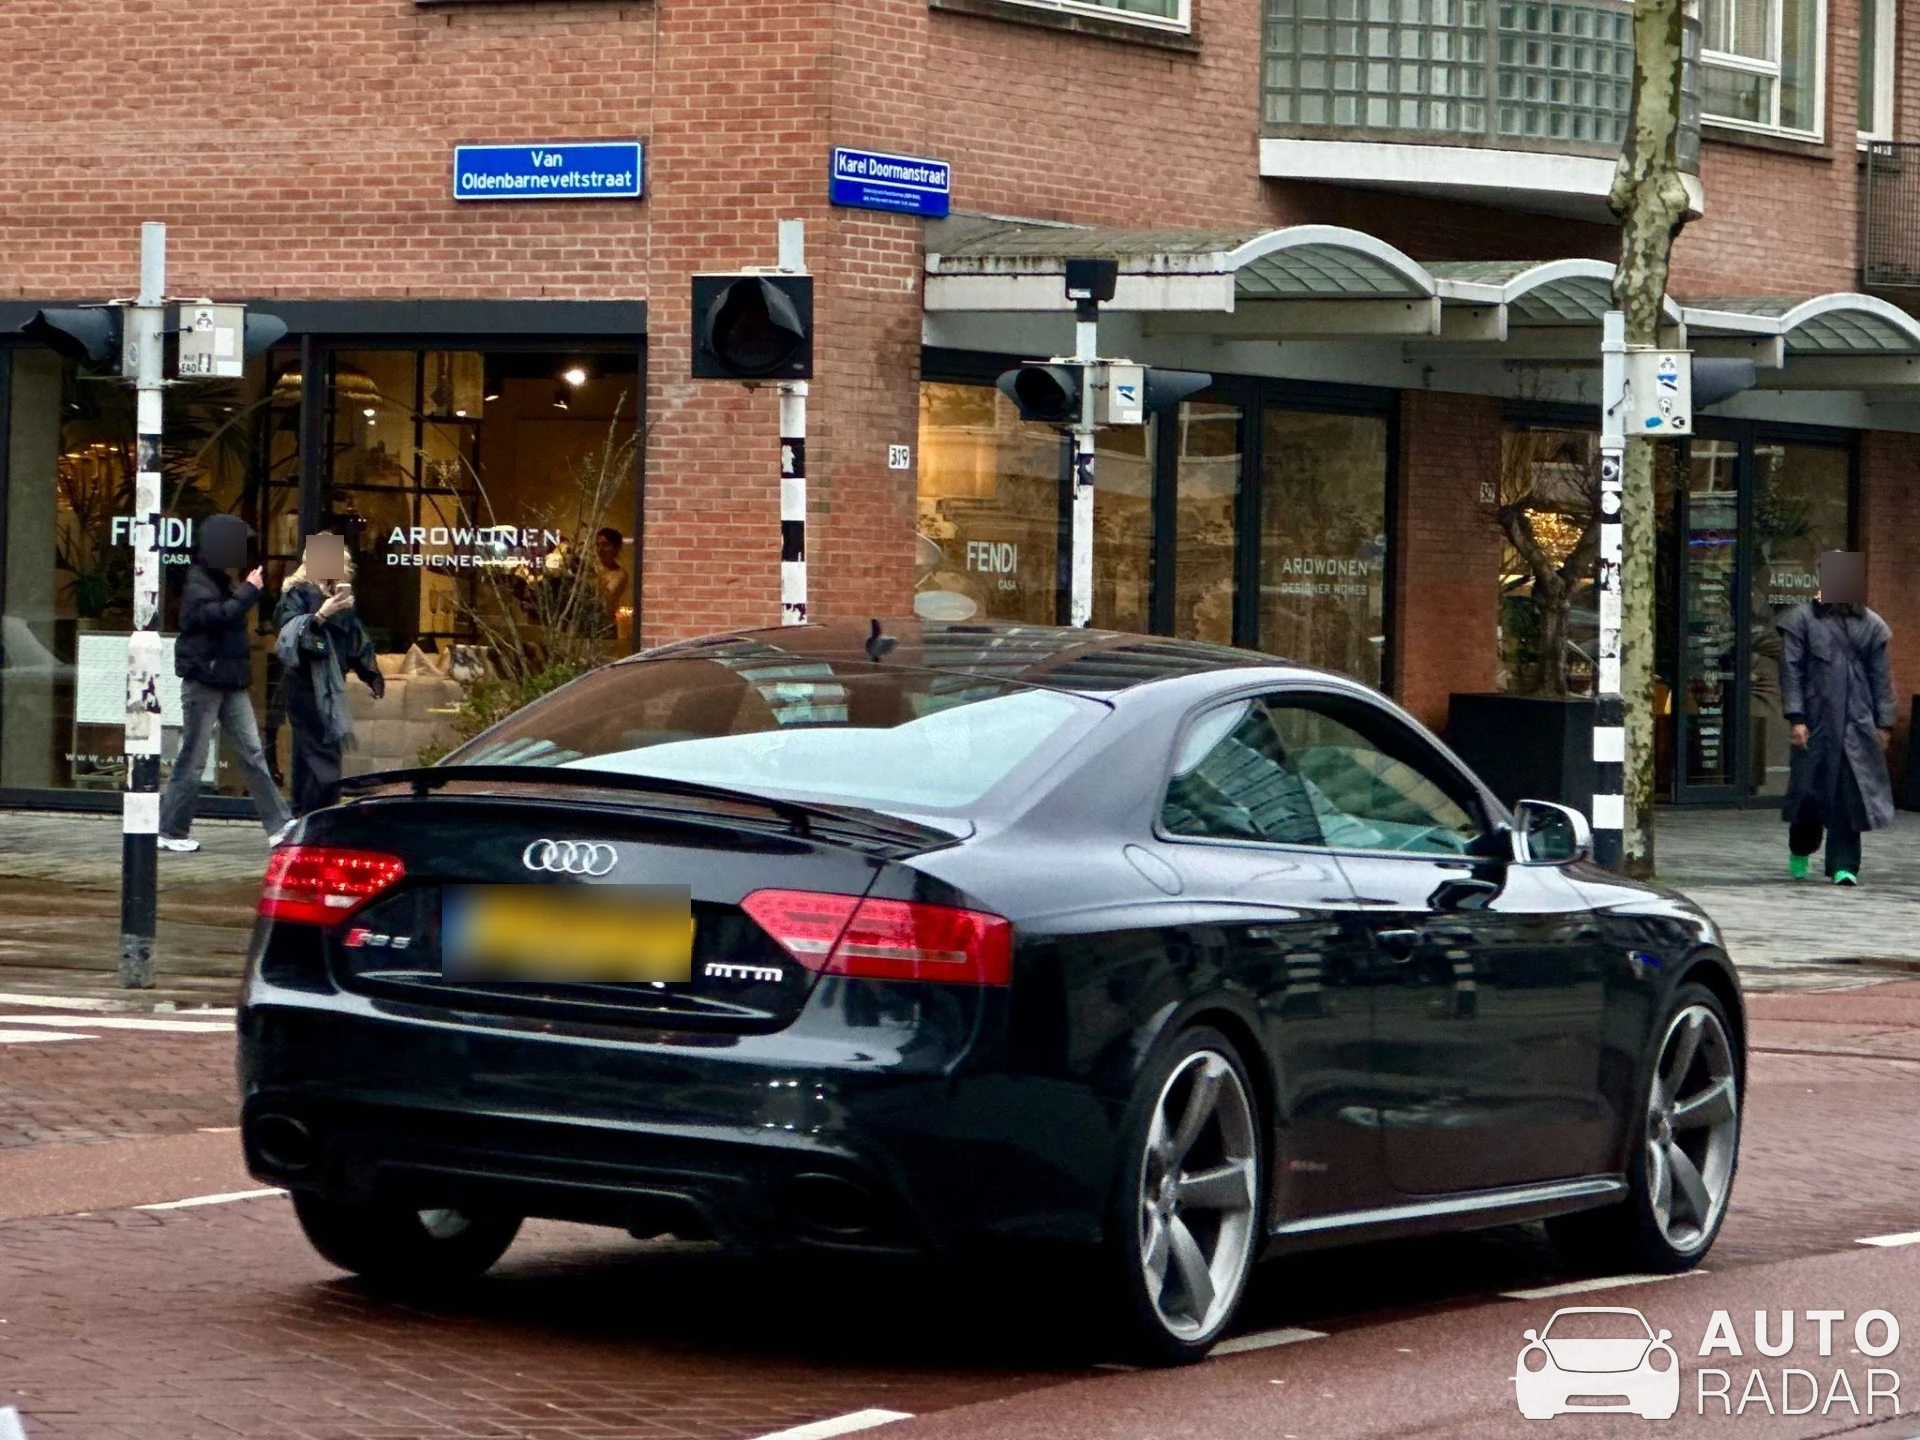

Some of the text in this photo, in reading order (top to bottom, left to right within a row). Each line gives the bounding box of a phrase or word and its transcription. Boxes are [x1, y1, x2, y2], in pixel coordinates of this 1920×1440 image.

[531, 151, 563, 168] Van
[839, 154, 945, 185] Karel Doormanstraat
[462, 170, 632, 189] Oldenbarneveltstraat
[891, 447, 908, 465] 319
[388, 526, 560, 546] AROWONEN
[162, 554, 191, 565] CASA
[387, 554, 483, 568] DESIGNER
[966, 541, 1017, 573] FENDI
[1769, 573, 1820, 588] AROWON
